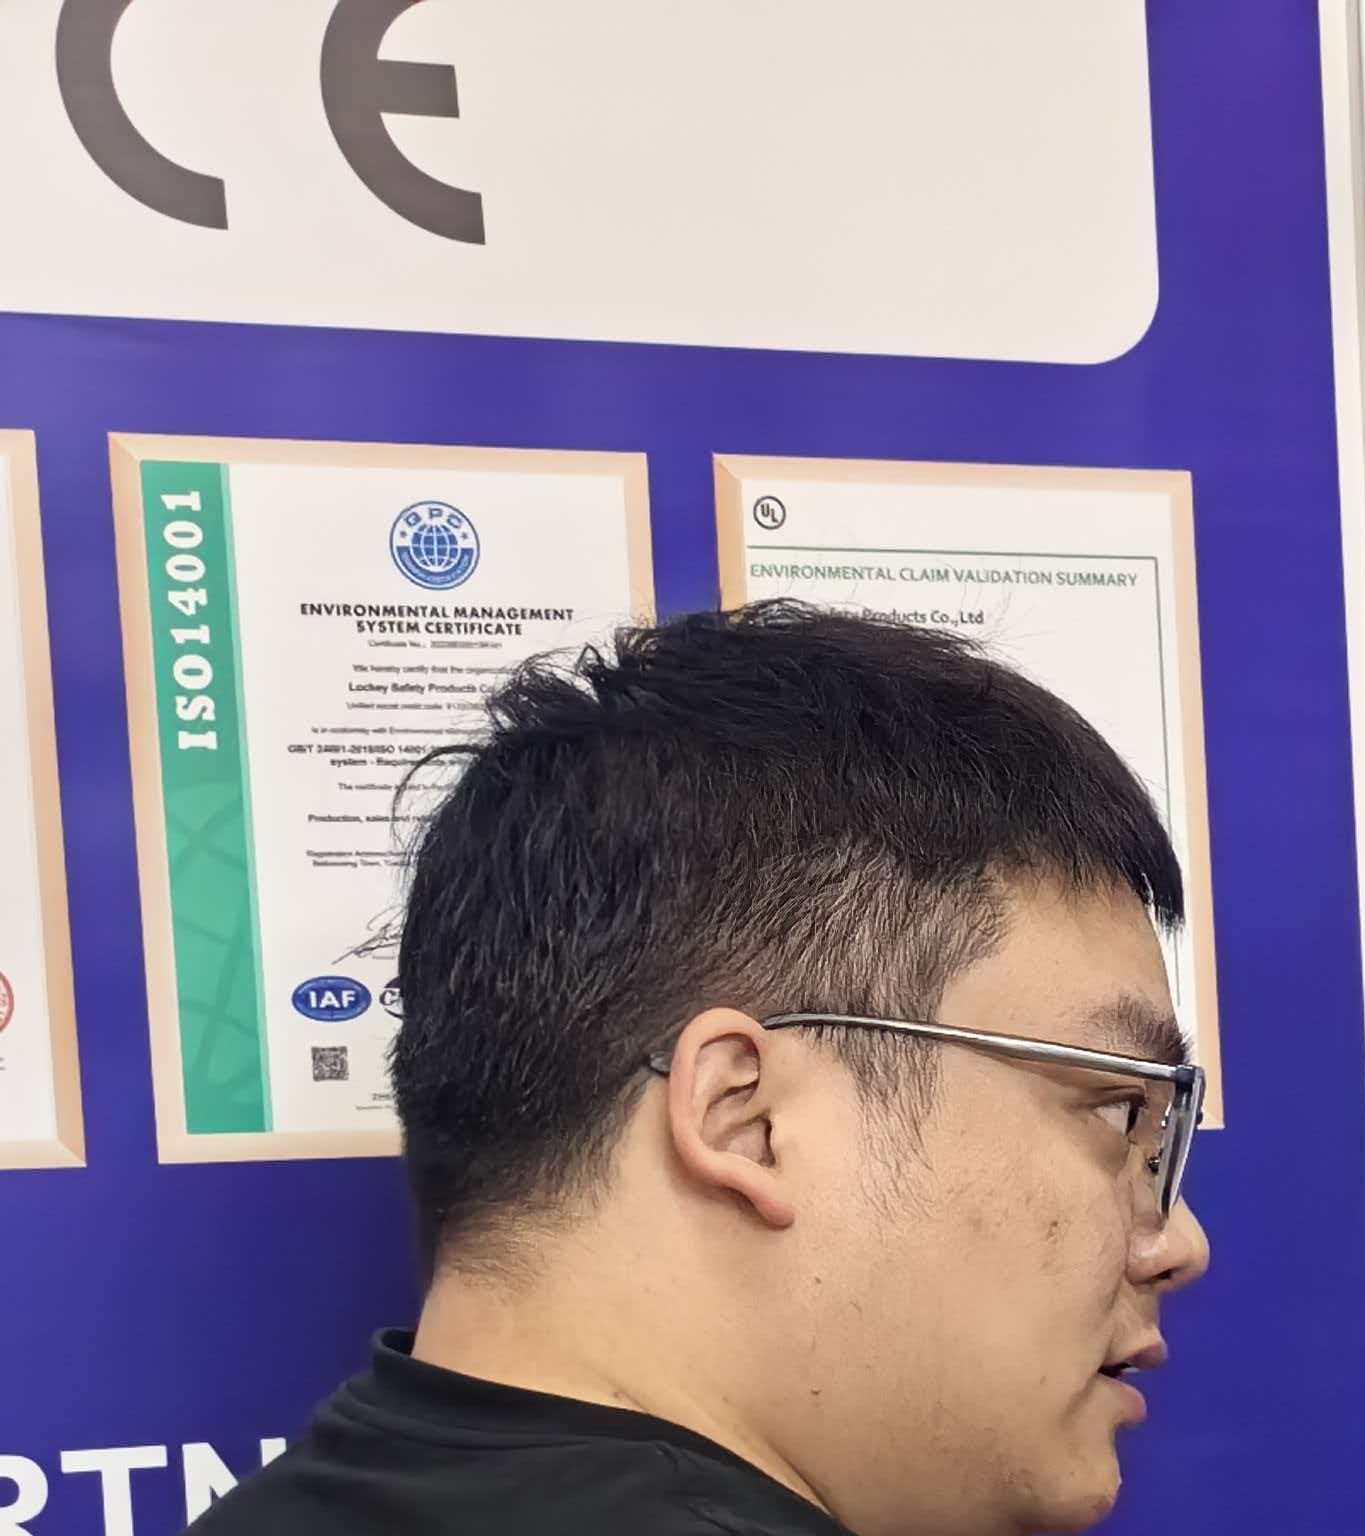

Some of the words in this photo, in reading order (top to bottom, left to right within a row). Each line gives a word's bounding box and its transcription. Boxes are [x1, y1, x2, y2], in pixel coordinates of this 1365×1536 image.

[55, 0, 486, 246] CE
[751, 563, 897, 581] ENVIRONMENTAL
[899, 566, 950, 583] CLAIM
[954, 568, 1053, 585] VALIDATION
[1056, 571, 1138, 588] SUMMARY
[160, 489, 219, 752] ISO14001
[300, 603, 451, 619] ENVIRONMENTAL
[454, 607, 574, 622] MANAGEMENT
[356, 620, 421, 634] SYSTEM
[425, 621, 523, 636] CERTIFICATE
[308, 990, 356, 1009] IAF
